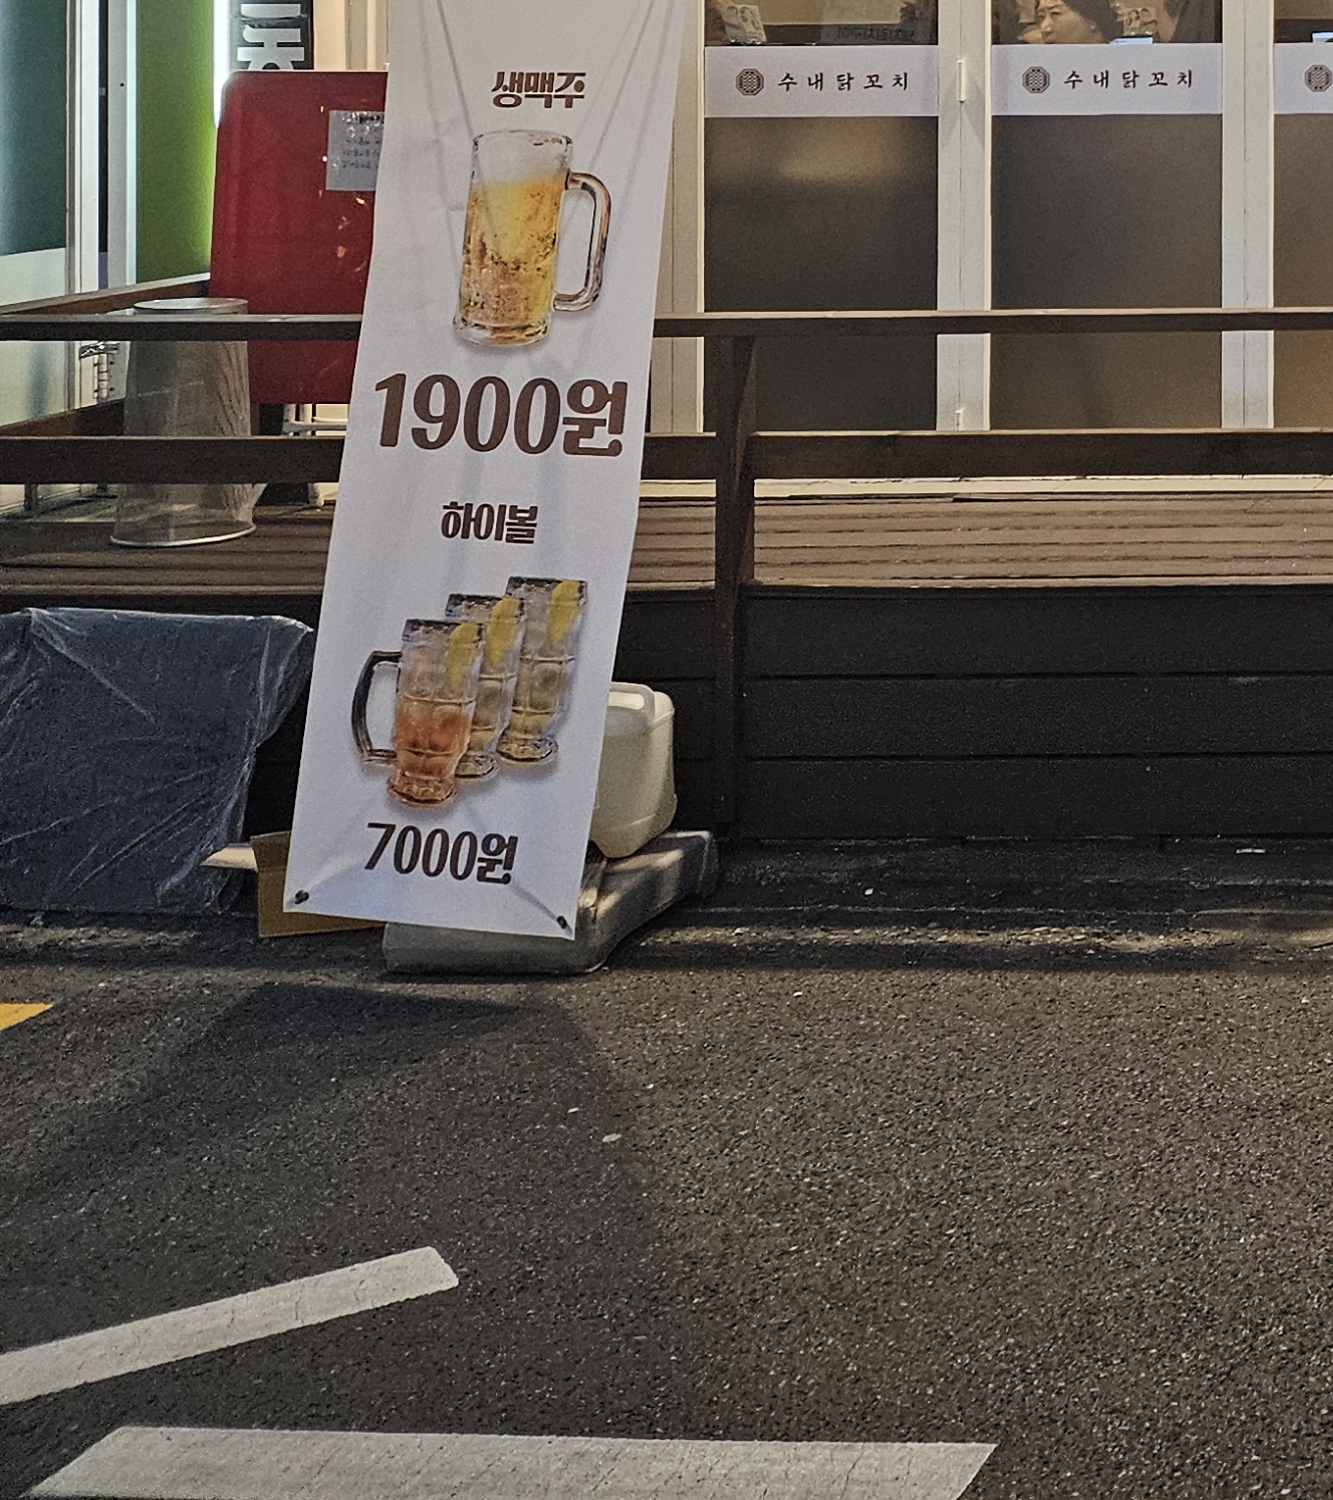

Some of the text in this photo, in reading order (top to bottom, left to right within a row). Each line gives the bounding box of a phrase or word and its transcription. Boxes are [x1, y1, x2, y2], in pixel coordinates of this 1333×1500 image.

[491, 70, 587, 110] 생맥주
[778, 71, 909, 92] 수내닭꼬치
[1063, 69, 1194, 90] 수내닭꼬치
[374, 371, 630, 458] 1900원
[440, 500, 539, 545] 하이볼
[363, 822, 519, 886] 7000원
